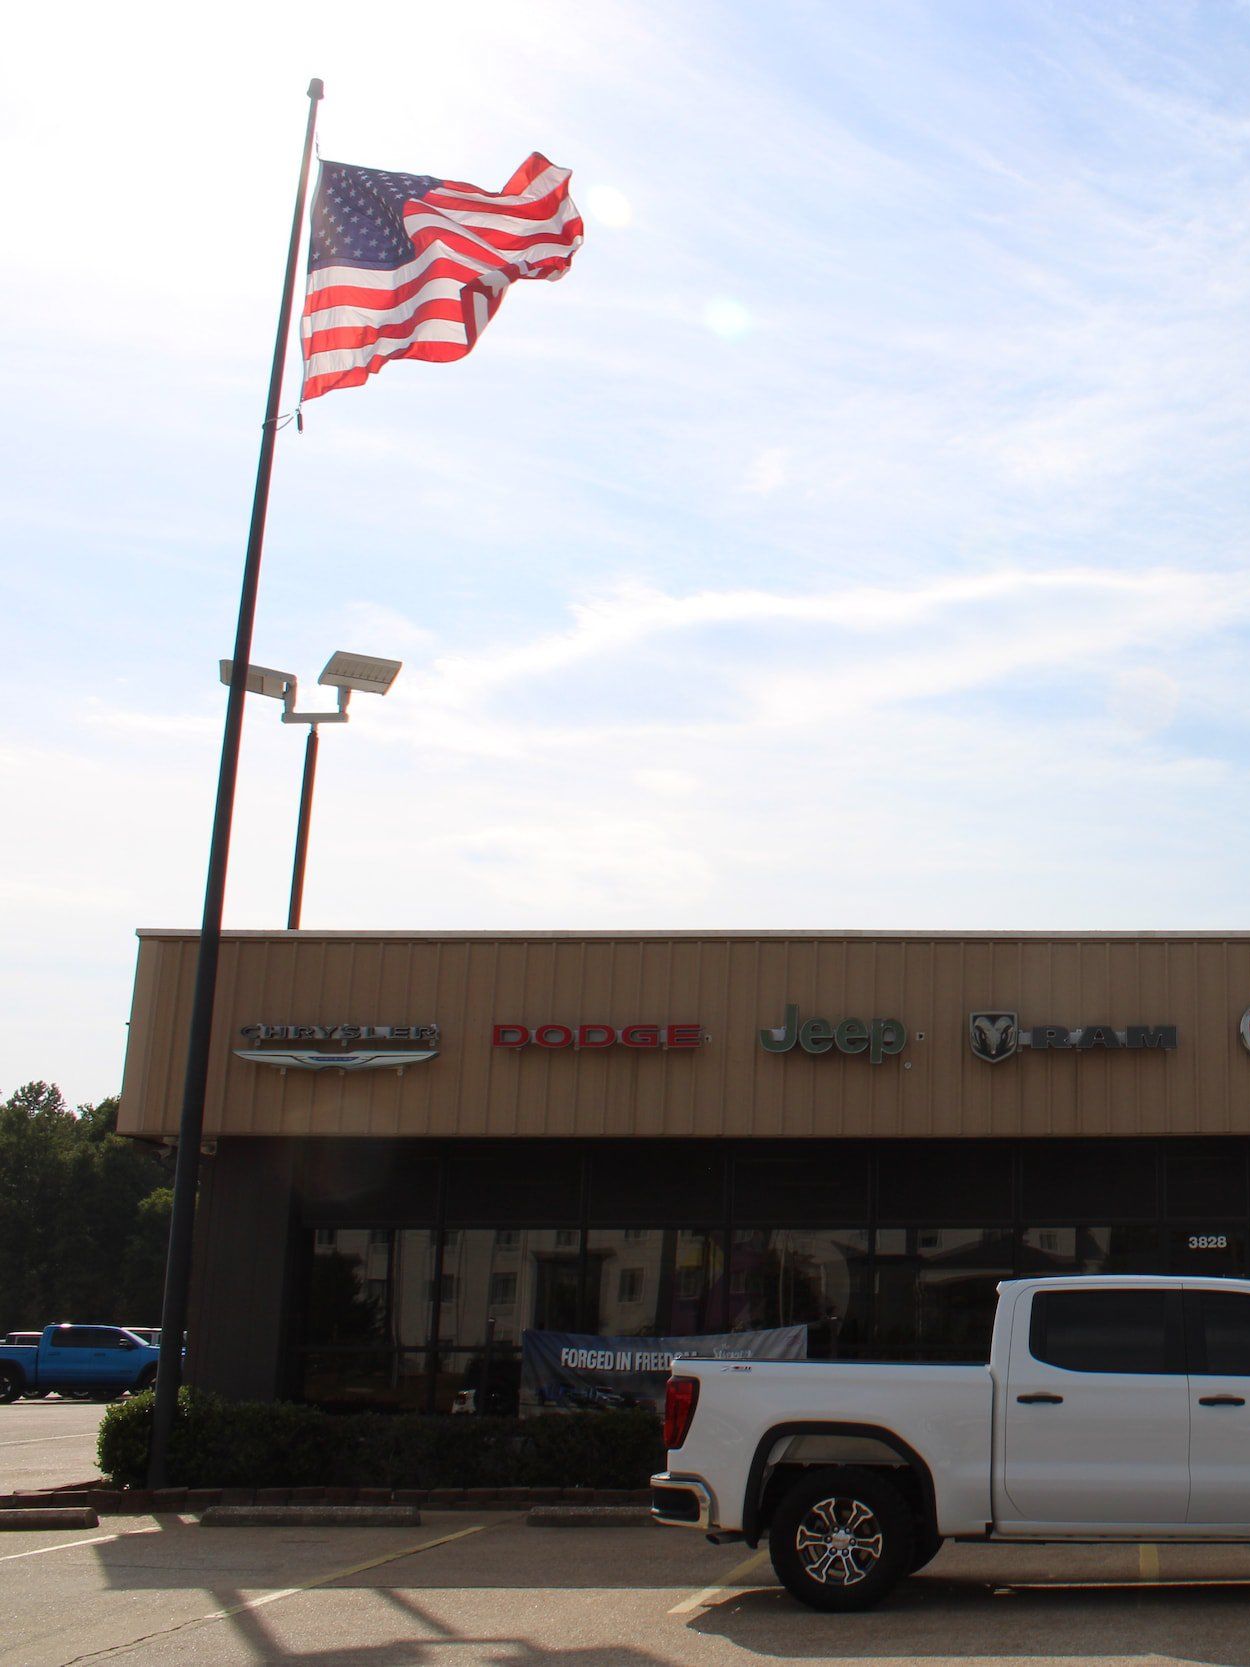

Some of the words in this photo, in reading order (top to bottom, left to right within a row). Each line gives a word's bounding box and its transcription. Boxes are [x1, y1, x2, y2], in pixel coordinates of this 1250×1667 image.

[240, 1024, 439, 1041] CHRYSLER
[493, 1024, 702, 1048] DODGE
[760, 1003, 907, 1063] Jeep
[1030, 1025, 1178, 1050] RAM
[1188, 1236, 1227, 1249] 3828
[560, 1347, 615, 1371] FORGED
[616, 1350, 632, 1372] IN
